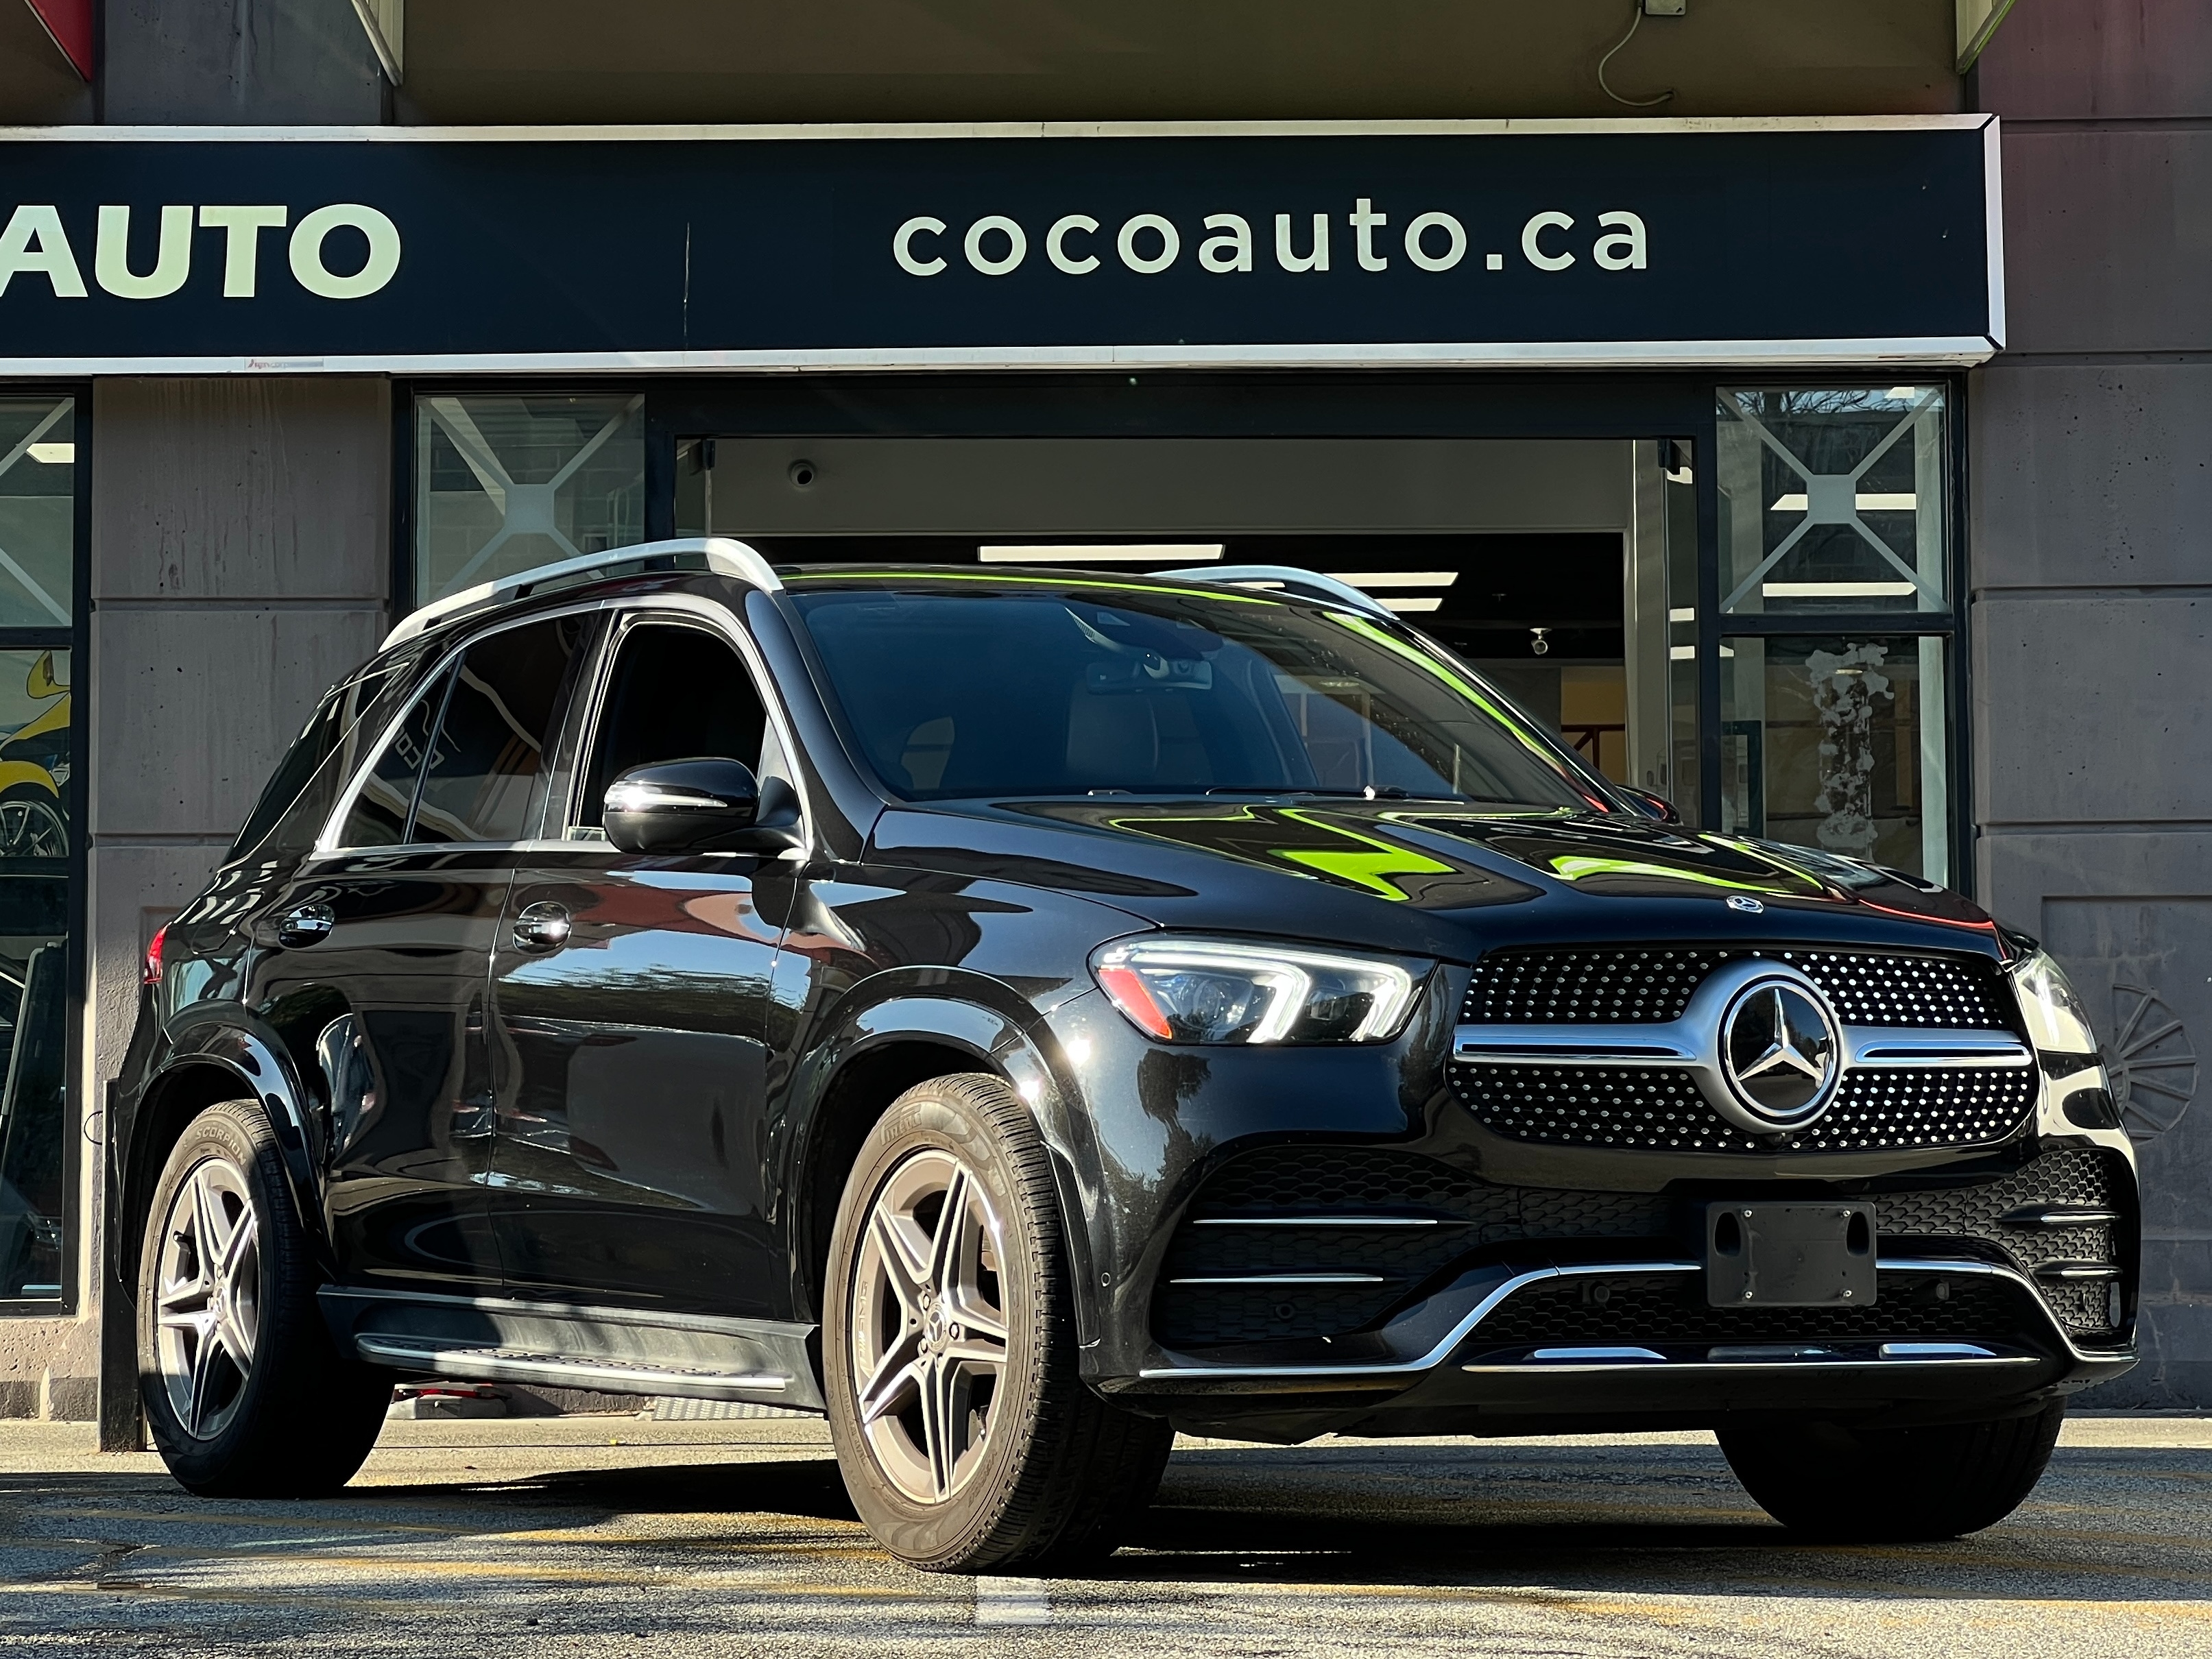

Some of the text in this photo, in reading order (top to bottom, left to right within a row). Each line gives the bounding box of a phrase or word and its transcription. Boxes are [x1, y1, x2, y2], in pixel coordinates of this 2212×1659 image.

[0, 204, 401, 299] AUTO
[893, 198, 1647, 276] cocoauto.ca
[195, 1126, 246, 1165] SCORPION
